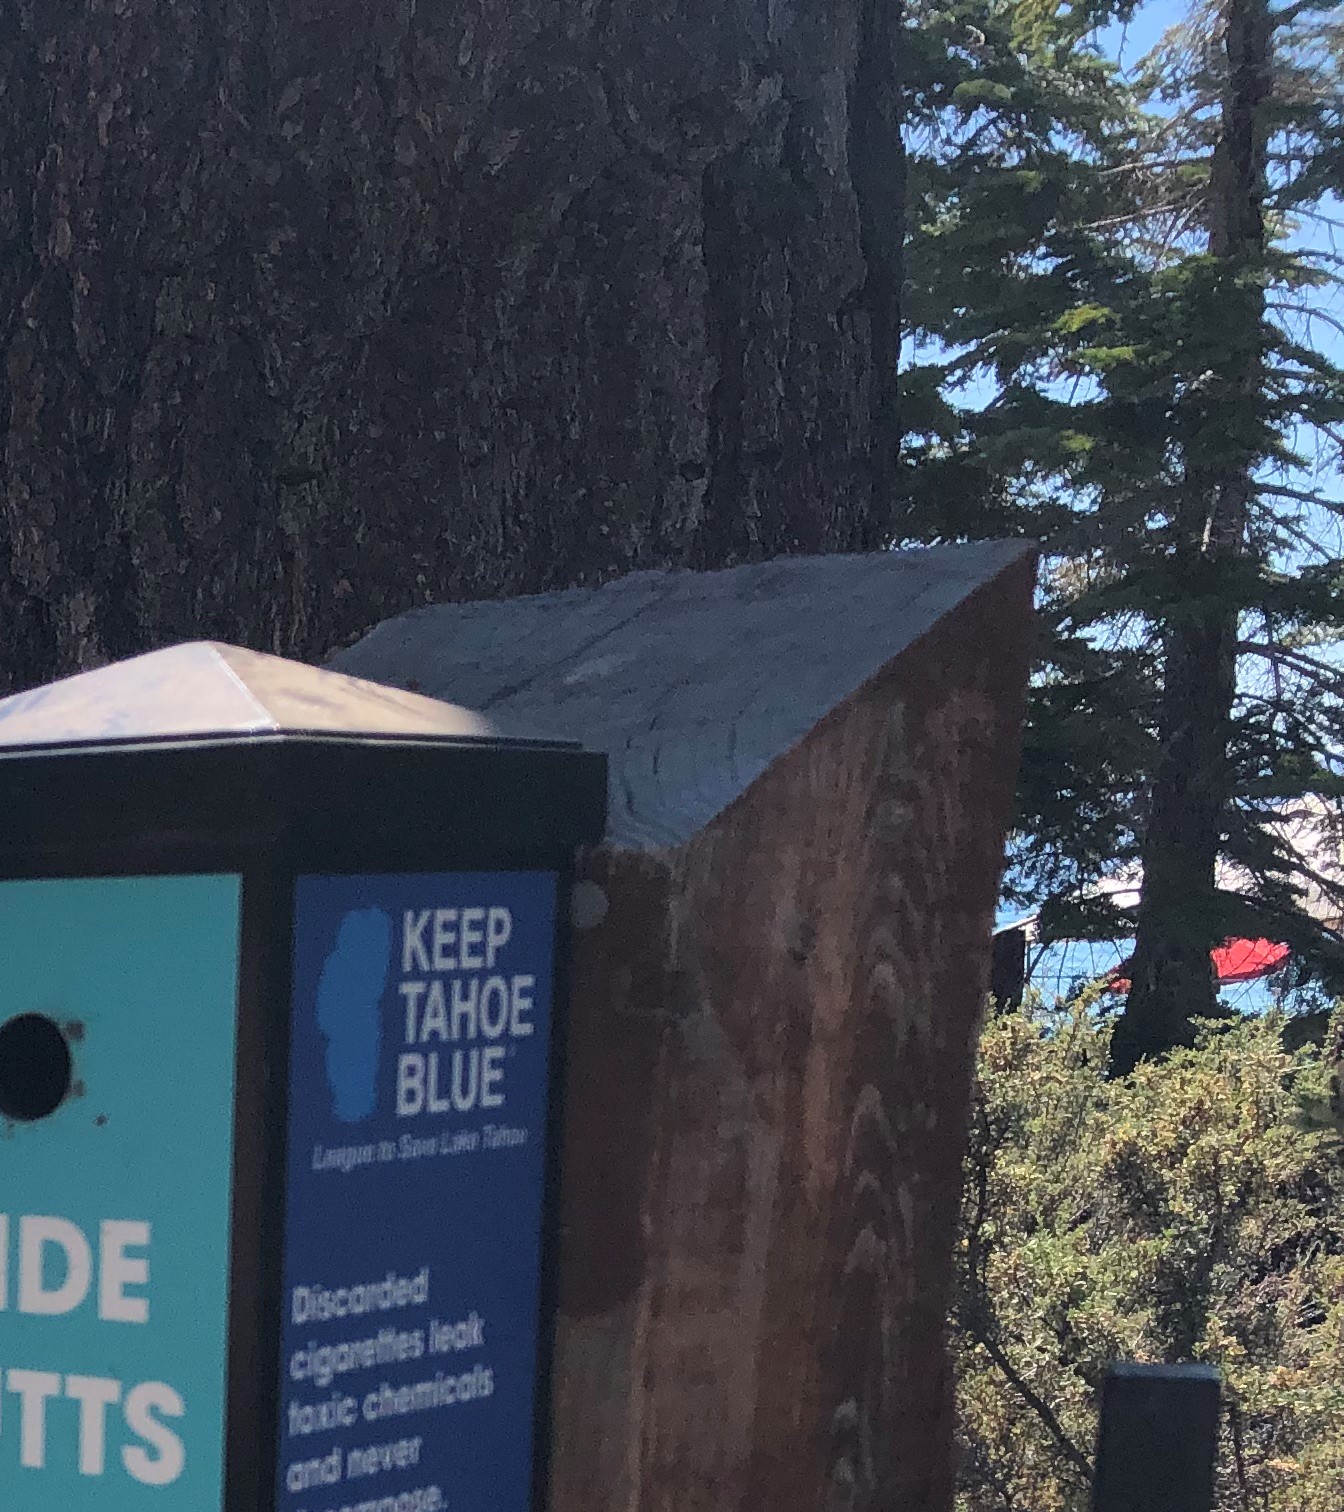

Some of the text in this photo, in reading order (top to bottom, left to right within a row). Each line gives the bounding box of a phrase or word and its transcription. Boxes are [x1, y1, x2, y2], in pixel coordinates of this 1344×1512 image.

[402, 906, 512, 972] KEEP
[398, 974, 536, 1044] TAHOE
[396, 1046, 506, 1118] BLUE
[312, 1124, 529, 1172] League to Save Lake Tahoe
[291, 1266, 429, 1324] Discarded
[290, 1310, 485, 1387] cigarettes leak
[288, 1363, 494, 1437] toxic chemicals
[286, 1436, 422, 1492] and never
